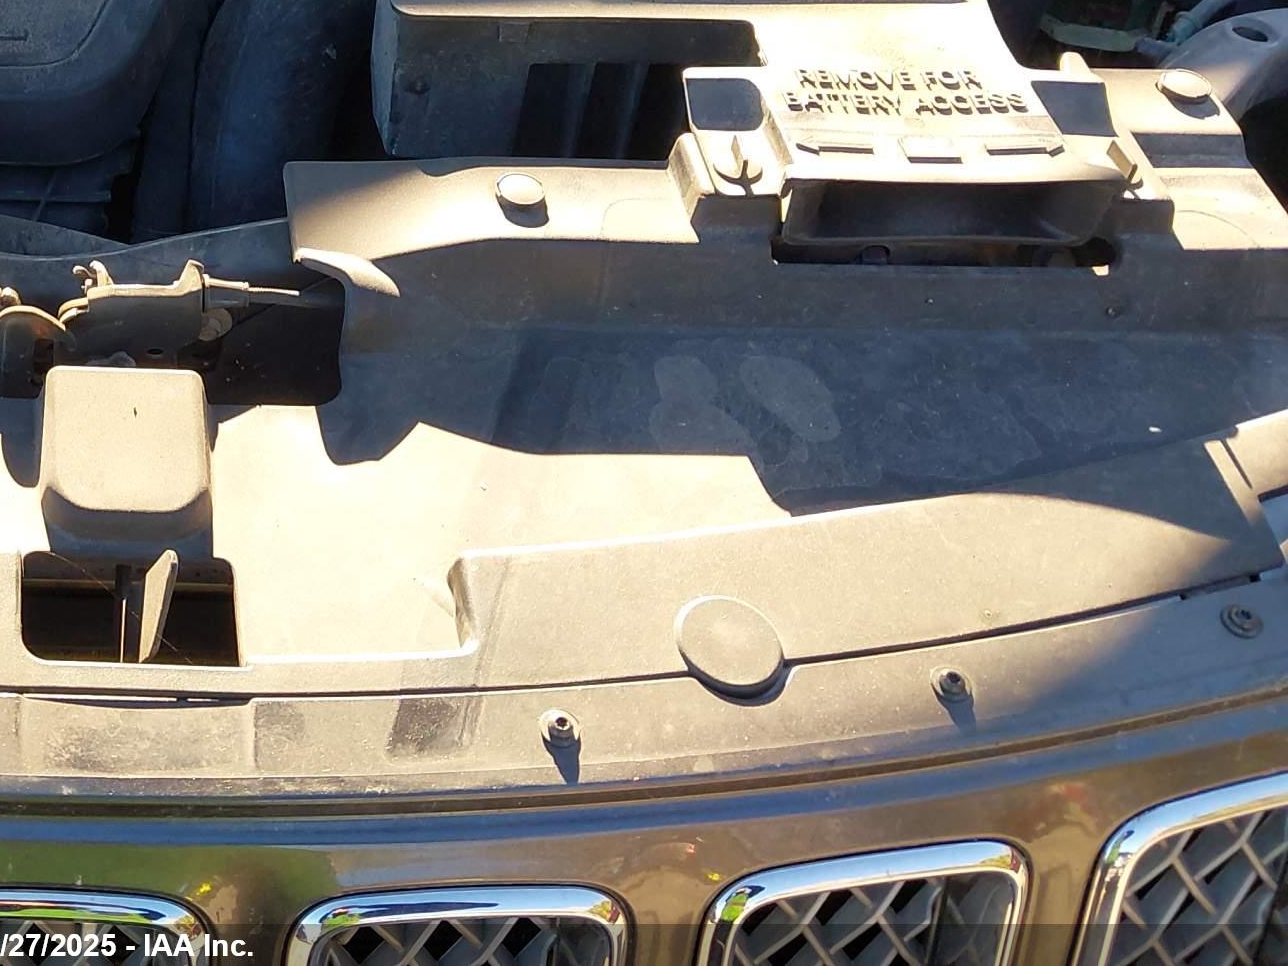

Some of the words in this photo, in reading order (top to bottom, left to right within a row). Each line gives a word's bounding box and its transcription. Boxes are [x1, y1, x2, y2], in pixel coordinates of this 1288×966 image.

[796, 68, 917, 92] REMOVE
[920, 70, 983, 92] FOR
[784, 91, 902, 116] BATTERY
[914, 93, 1030, 117] ACCESS
